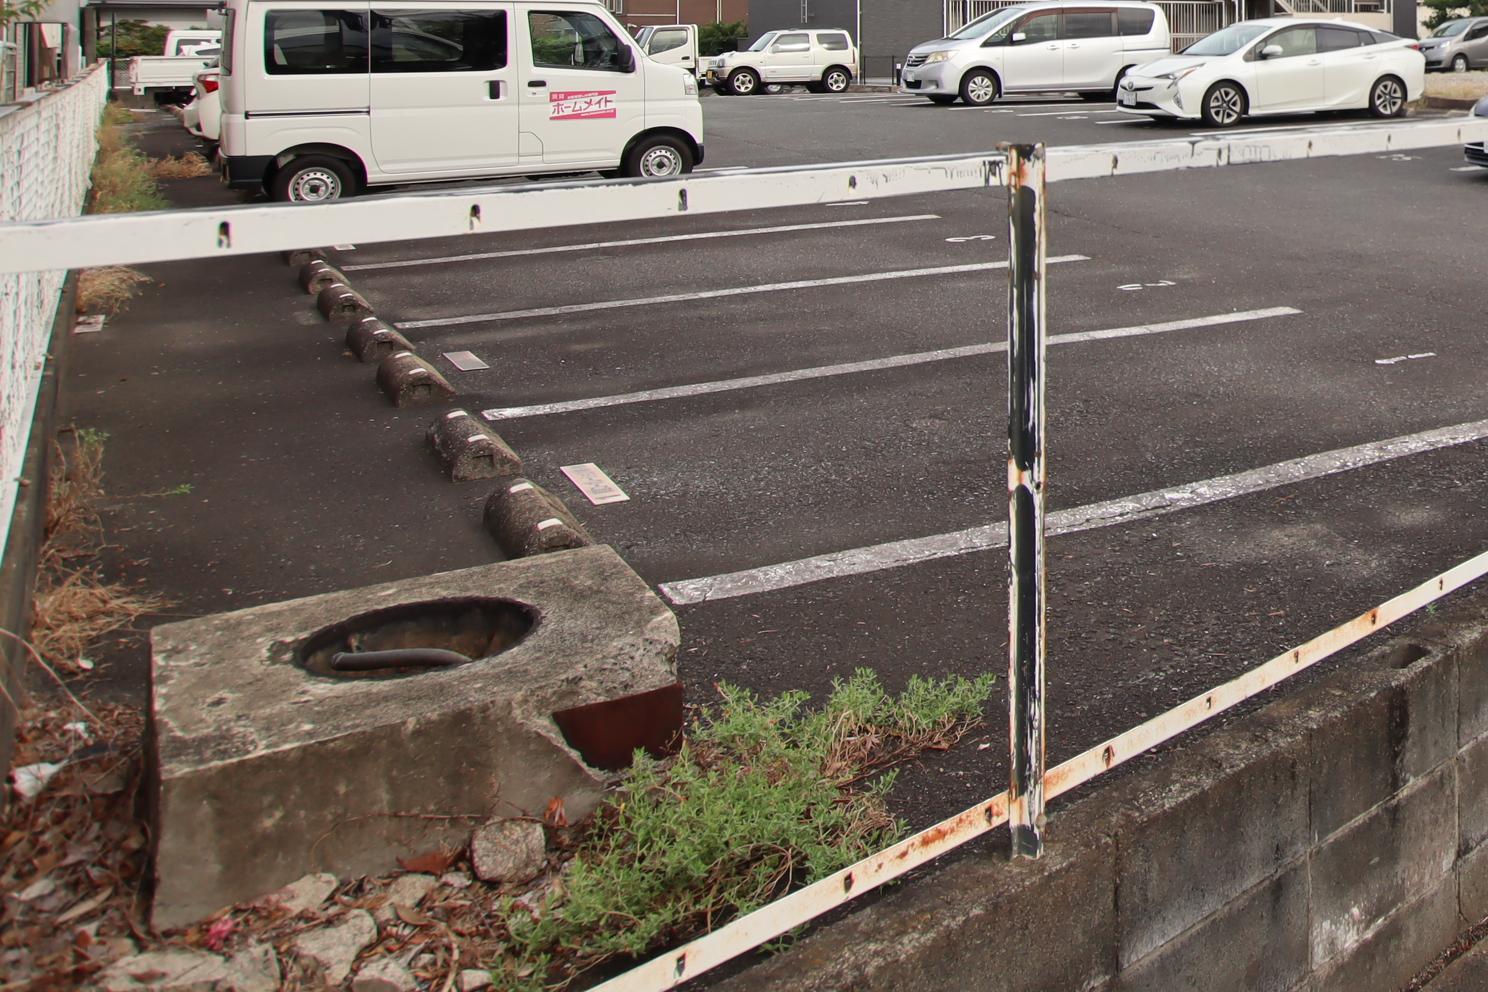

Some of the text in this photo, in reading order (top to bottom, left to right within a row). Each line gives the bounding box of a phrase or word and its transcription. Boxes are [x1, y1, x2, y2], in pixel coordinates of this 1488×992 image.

[552, 96, 613, 114] ホームメイト
